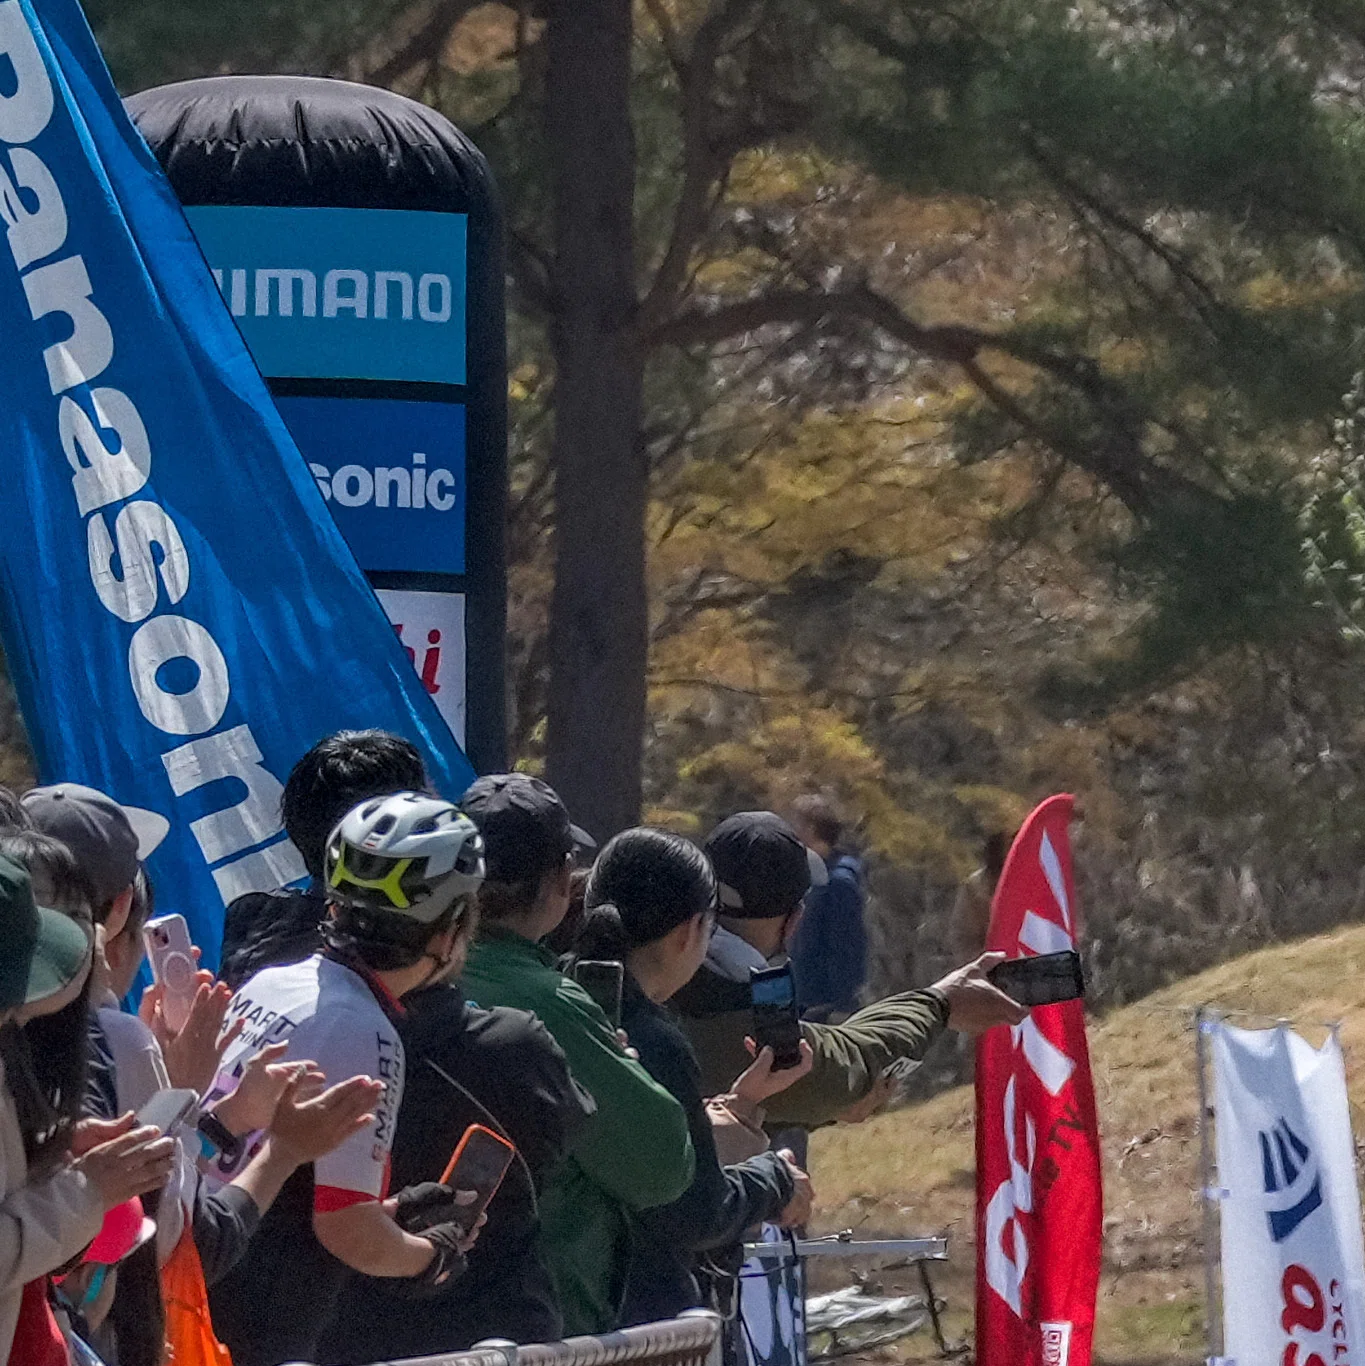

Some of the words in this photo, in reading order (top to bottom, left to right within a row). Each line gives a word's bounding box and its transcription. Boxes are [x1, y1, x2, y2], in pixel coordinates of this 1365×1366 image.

[211, 268, 451, 323] IMANO
[0, 0, 309, 906] Panasoni
[309, 453, 456, 511] sonic
[232, 993, 298, 1035] MART
